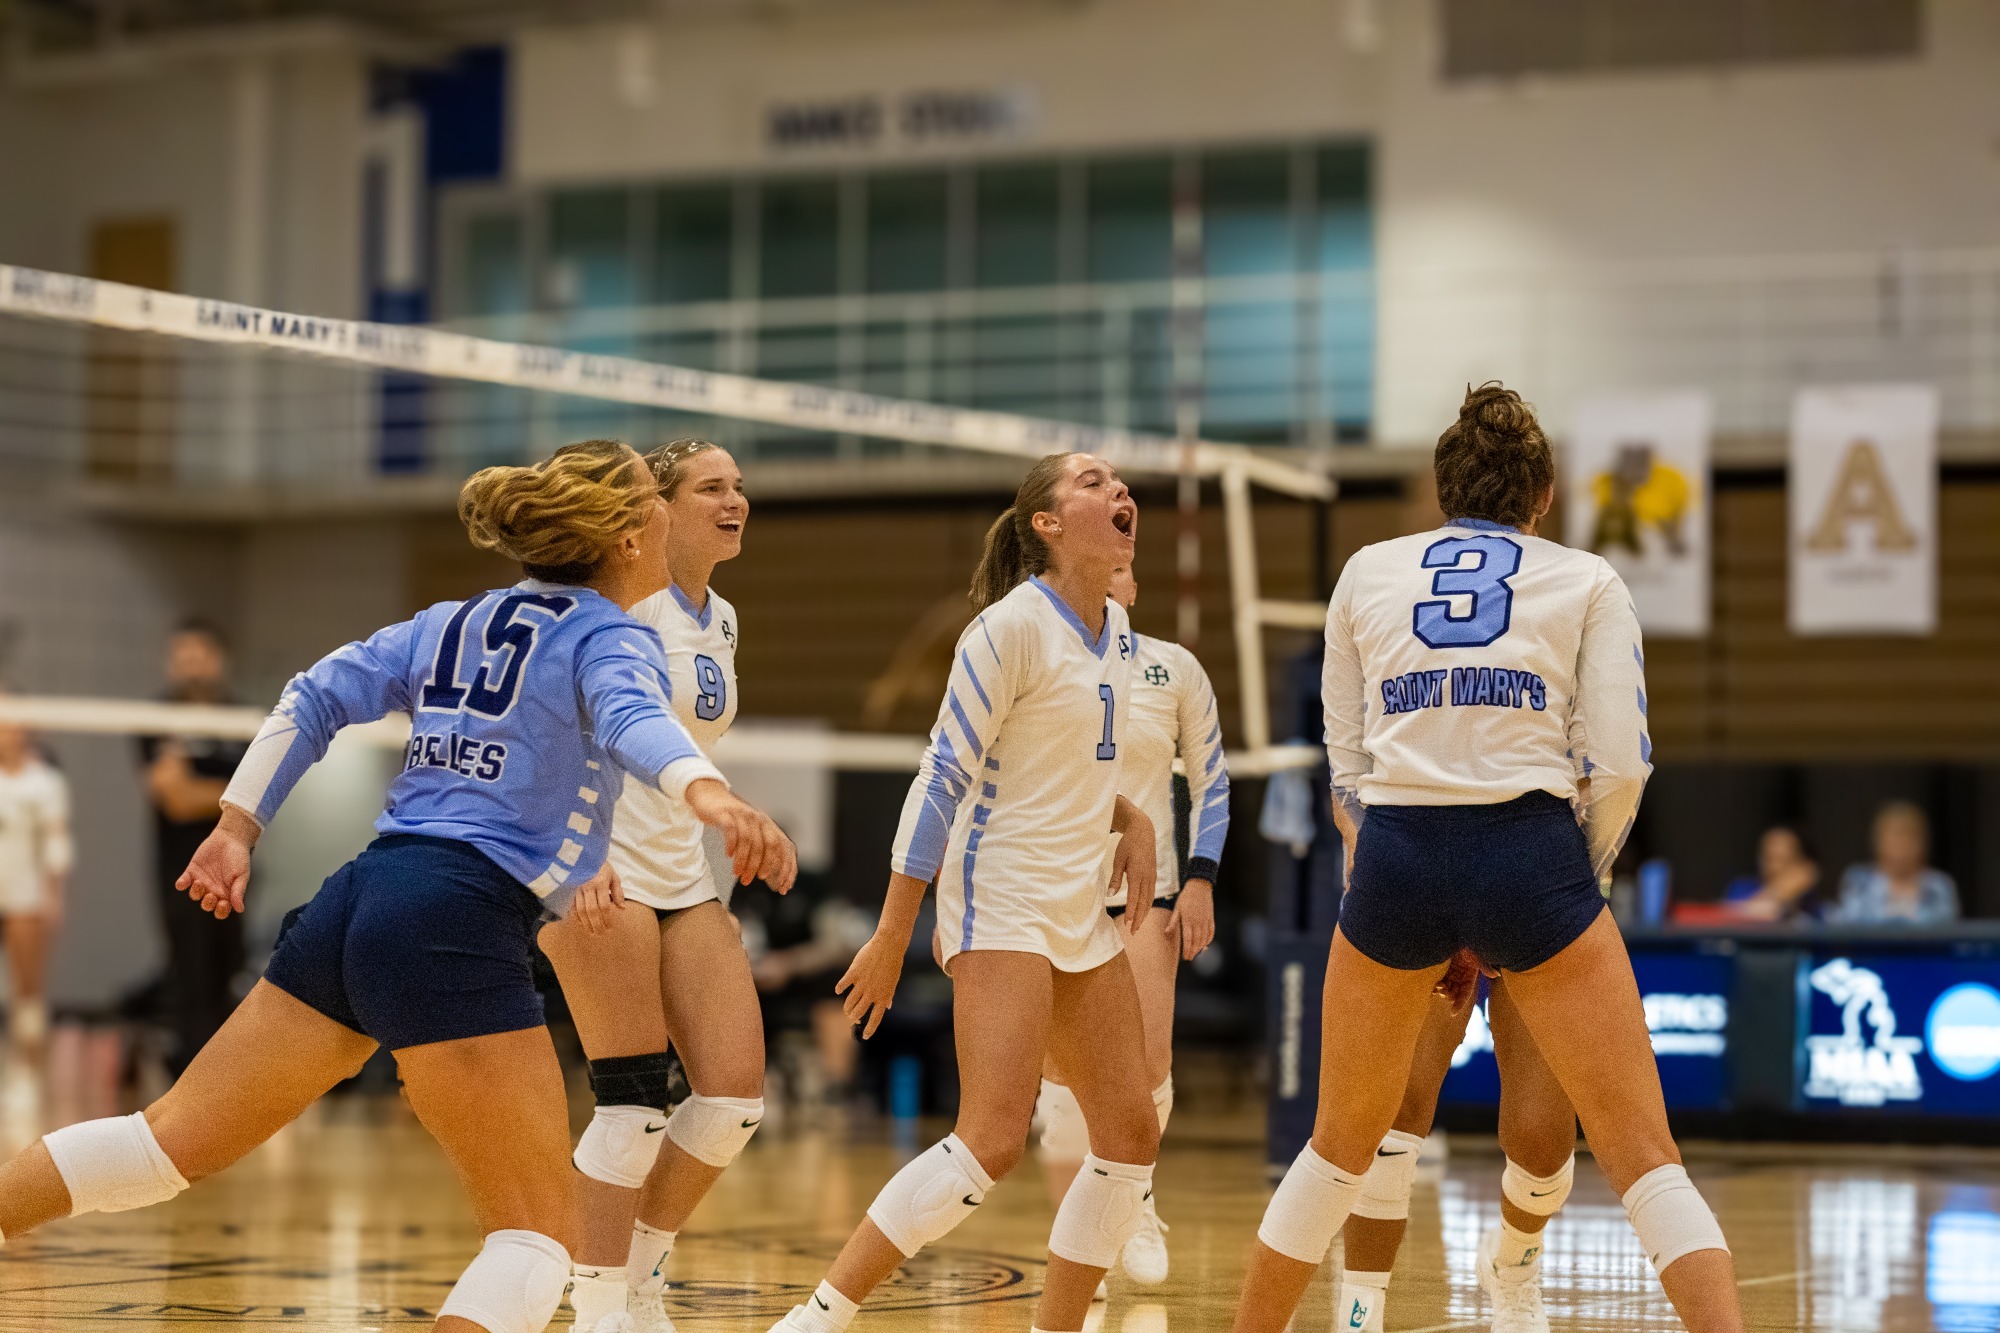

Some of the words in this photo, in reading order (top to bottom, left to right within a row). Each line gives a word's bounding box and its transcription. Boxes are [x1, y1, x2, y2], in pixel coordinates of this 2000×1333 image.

[1805, 440, 1917, 552] A
[1413, 534, 1523, 649] 3
[418, 590, 579, 721] 15
[694, 653, 726, 721] 9
[1381, 669, 1447, 715] SAINT
[1451, 667, 1546, 711] MARY'S
[1097, 684, 1115, 761] 1
